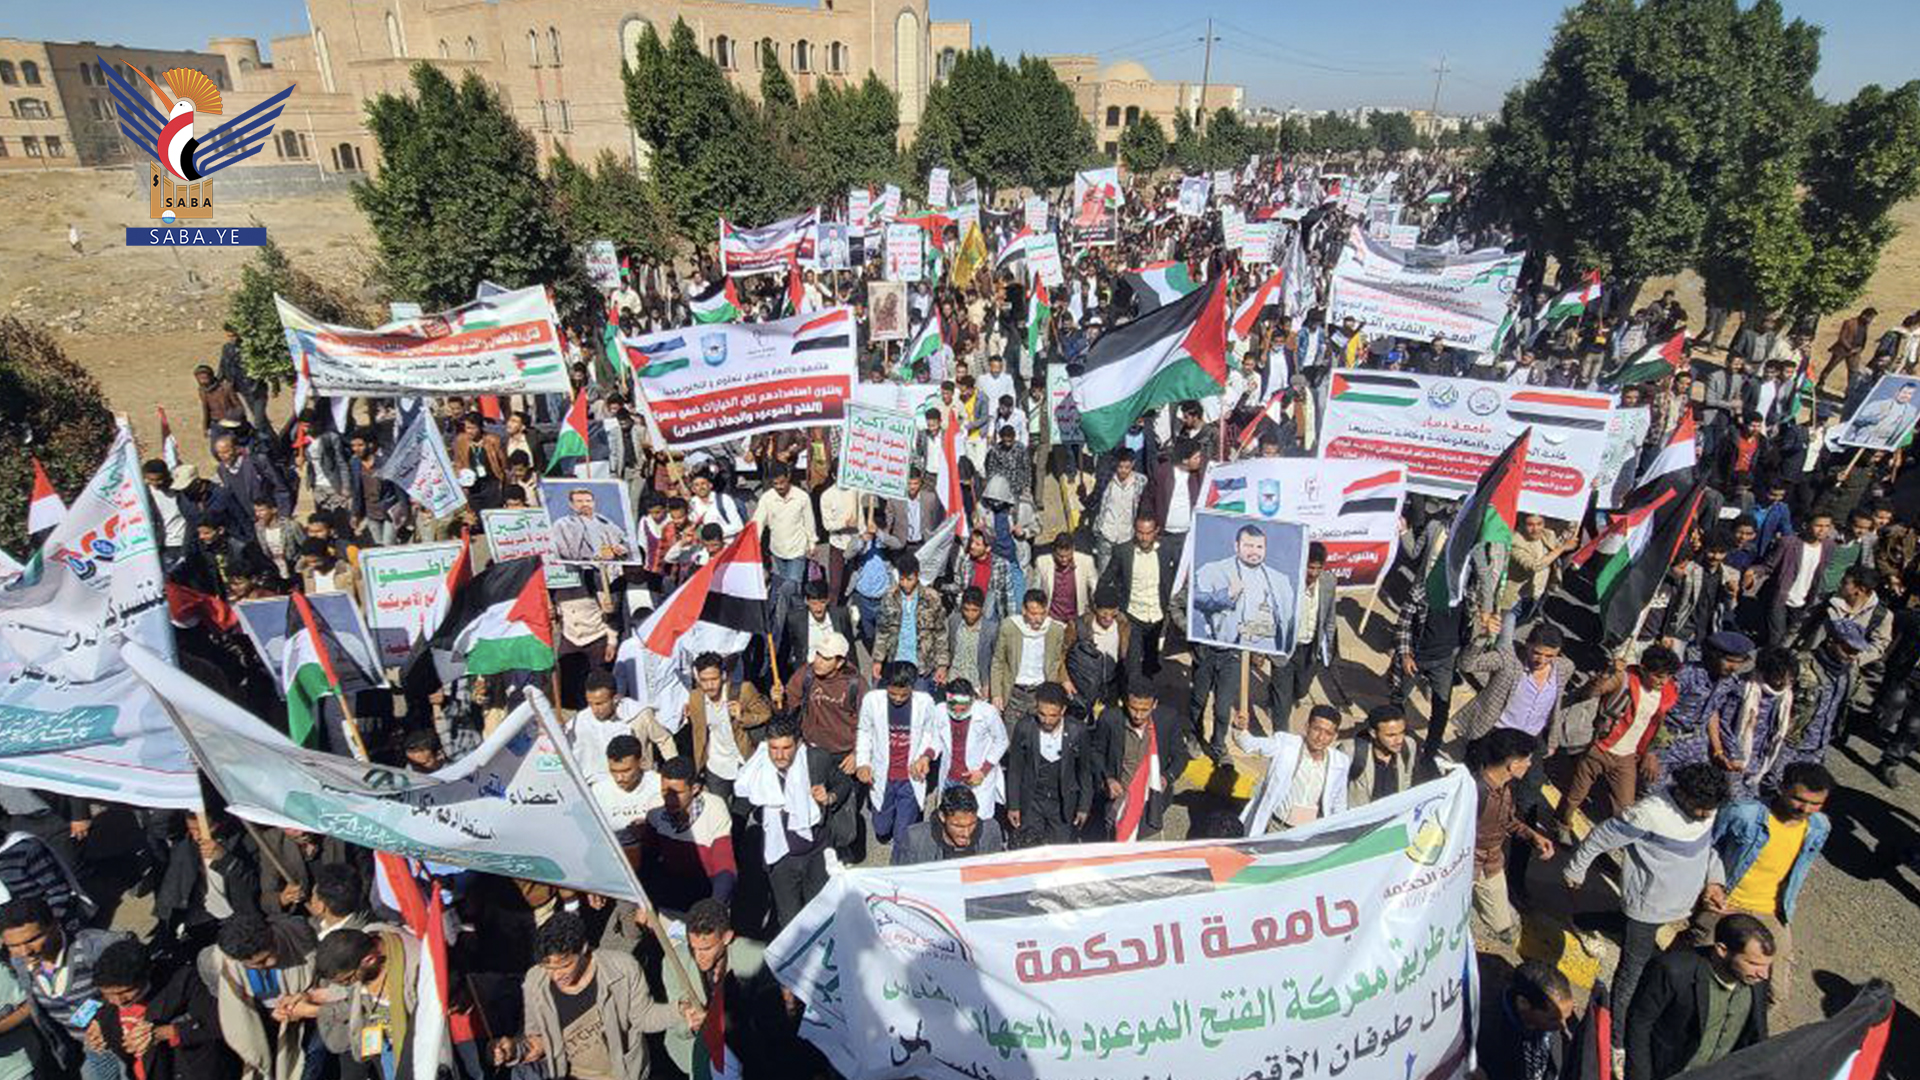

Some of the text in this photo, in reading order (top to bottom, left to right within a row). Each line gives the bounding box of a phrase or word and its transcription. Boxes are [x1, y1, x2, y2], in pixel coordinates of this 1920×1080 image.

[1015, 921, 1185, 984] الحكمة
[1200, 895, 1360, 960] جامعة
[1394, 924, 1445, 995] طريق
[1199, 985, 1277, 1049] الفتح
[1282, 965, 1389, 1021] معركة
[1081, 999, 1192, 1060] الموعود
[1329, 1012, 1413, 1078] طوفان
